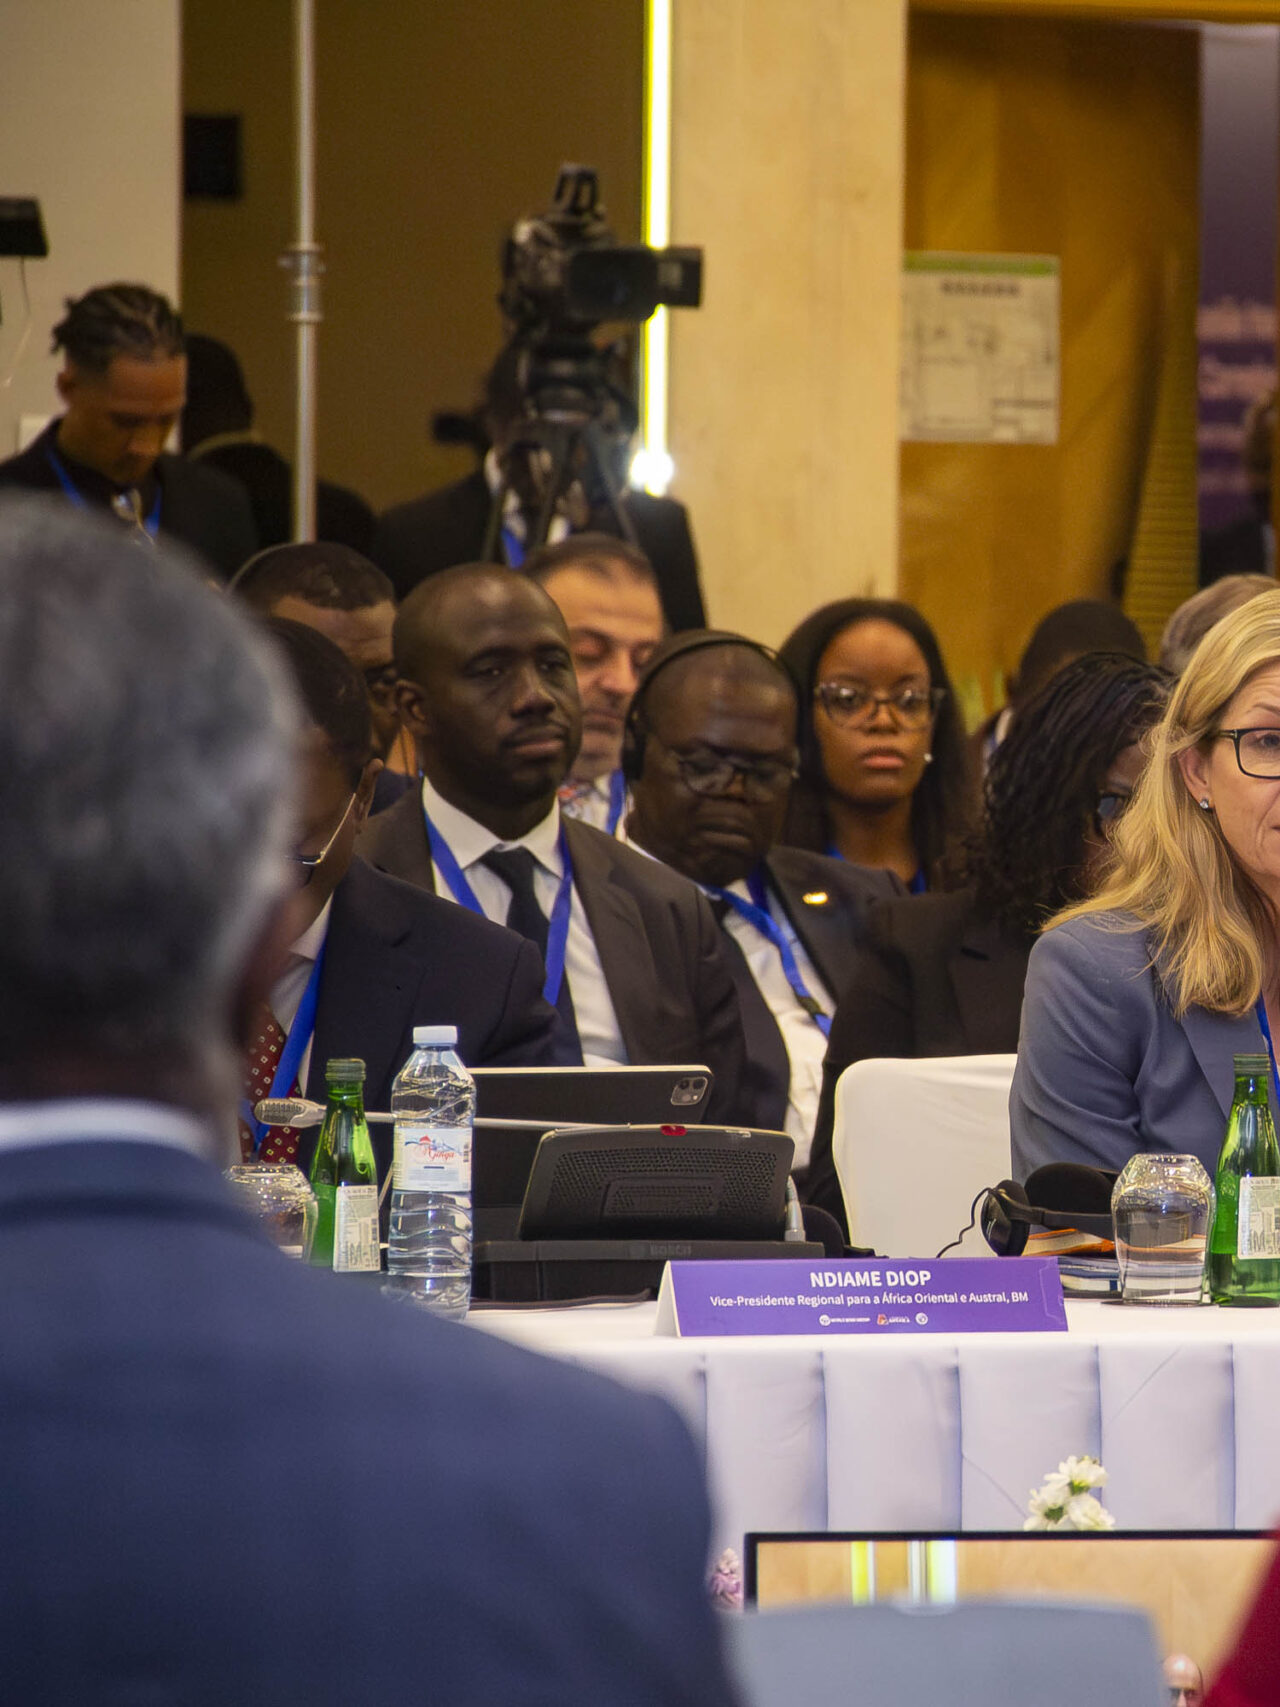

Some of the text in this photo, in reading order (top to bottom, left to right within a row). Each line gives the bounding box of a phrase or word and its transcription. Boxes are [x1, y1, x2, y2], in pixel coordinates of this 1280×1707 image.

[810, 1270, 931, 1288] NDIAME DIOP
[710, 1291, 1028, 1307] Vice-Presidente Regional para a África Oriental e Austral, BM
